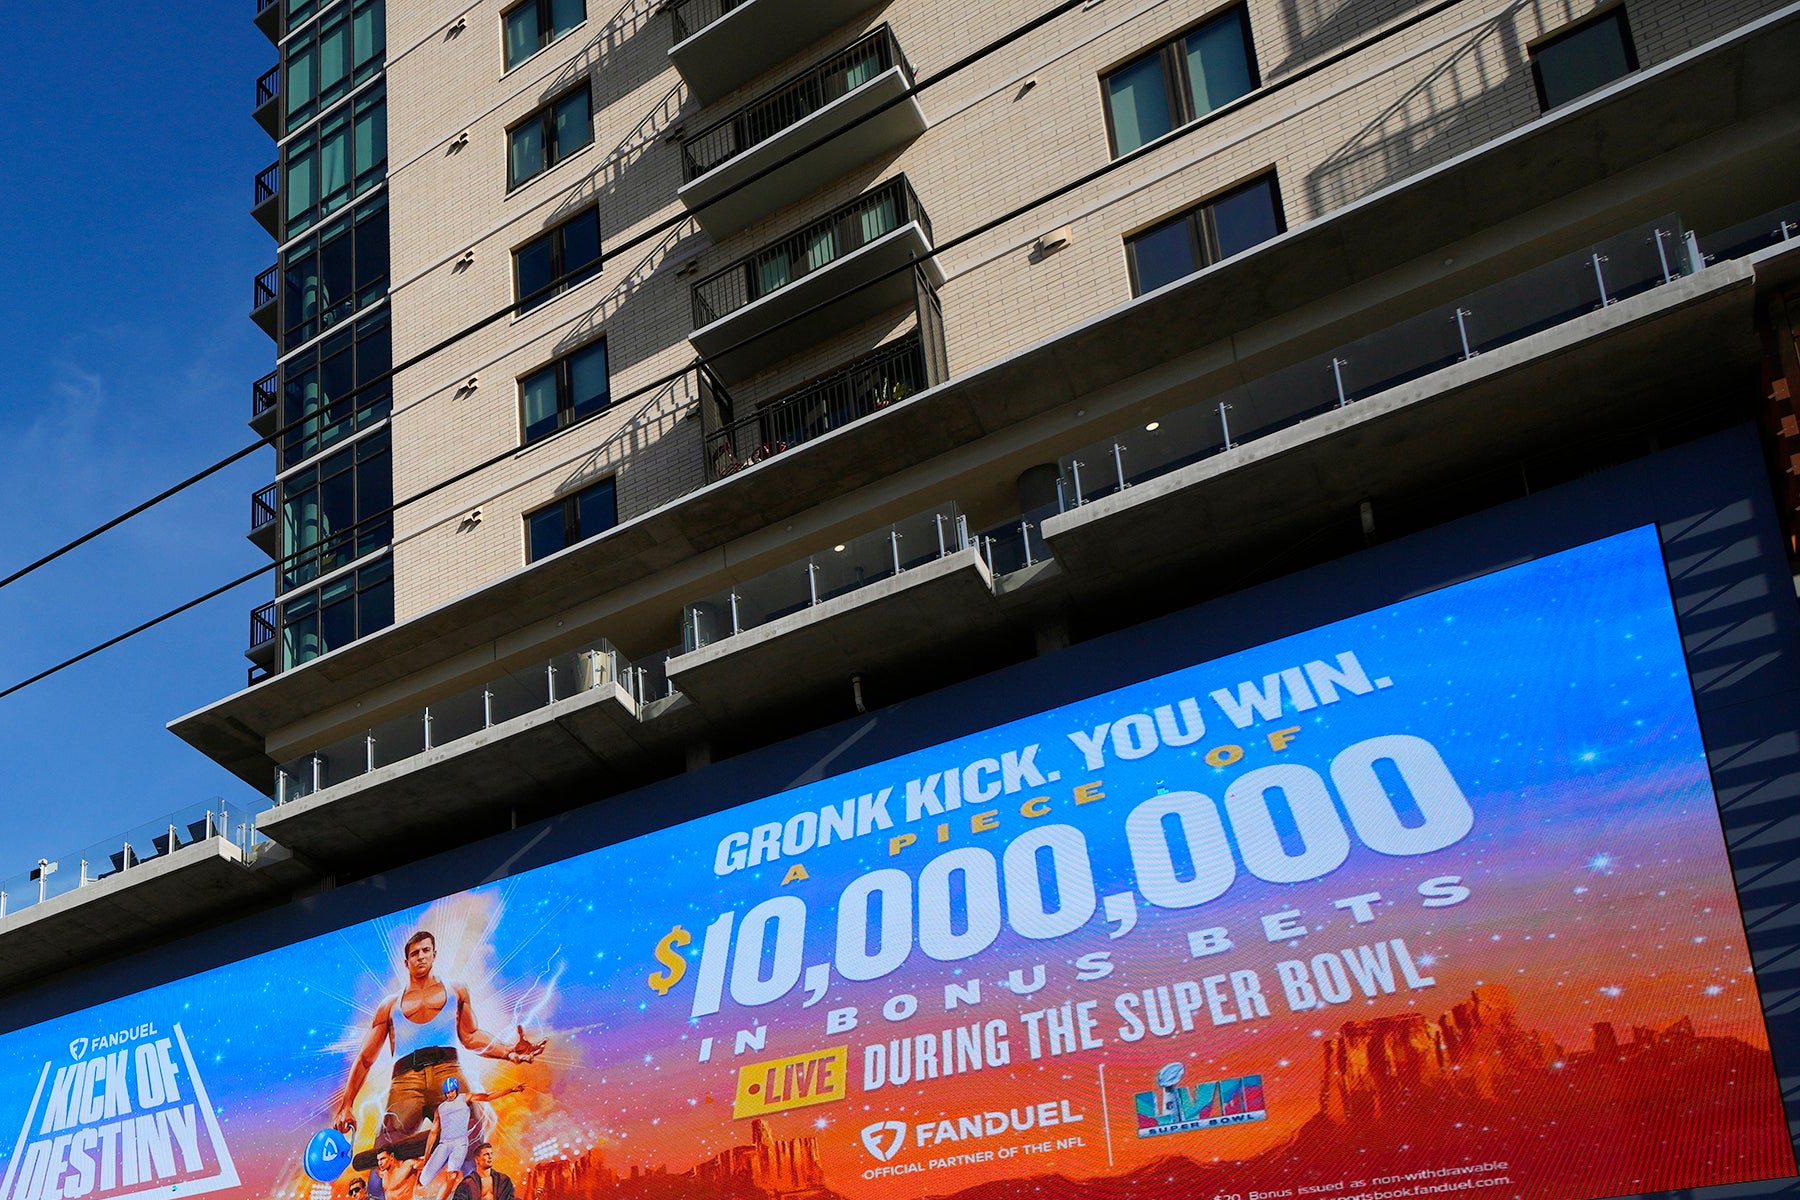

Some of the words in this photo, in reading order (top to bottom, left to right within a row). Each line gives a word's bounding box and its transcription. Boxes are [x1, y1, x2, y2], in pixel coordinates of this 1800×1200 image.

[714, 787, 894, 876] GRONK
[905, 744, 1061, 823] KICK.
[1067, 697, 1206, 770] YOU
[1209, 650, 1394, 729] WIN.
[780, 864, 809, 886] A
[889, 781, 1106, 856] PIECE
[1205, 726, 1301, 767] OF
[648, 734, 1474, 1018] $10,000,000
[698, 1025, 767, 1062] IN
[826, 951, 1114, 1035] BONUS
[1186, 875, 1470, 958] BETS
[91, 1022, 157, 1052] FANDUEL
[764, 1056, 836, 1105] LIVE
[863, 1019, 1010, 1092] DURING
[1020, 999, 1104, 1060] THE
[1114, 969, 1270, 1042] SUPER
[1277, 937, 1436, 1012] BOWL
[40, 1049, 131, 1134] KICK
[135, 1037, 183, 1111] OF
[915, 1099, 1084, 1147] FANDUEL
[1149, 1122, 1199, 1134] SUPER
[1209, 1114, 1255, 1125] BOWL
[863, 1161, 925, 1181] OFFICIAL
[928, 1151, 994, 1170] PARTNER
[998, 1147, 1018, 1159] OF
[1022, 1142, 1052, 1155] THE
[1056, 1136, 1086, 1150] NFL
[1249, 1188, 1292, 1200] Bonus
[1298, 1181, 1344, 1195] issued
[1350, 1179, 1366, 1188] as
[1372, 1160, 1509, 1186] non-withdrawable
